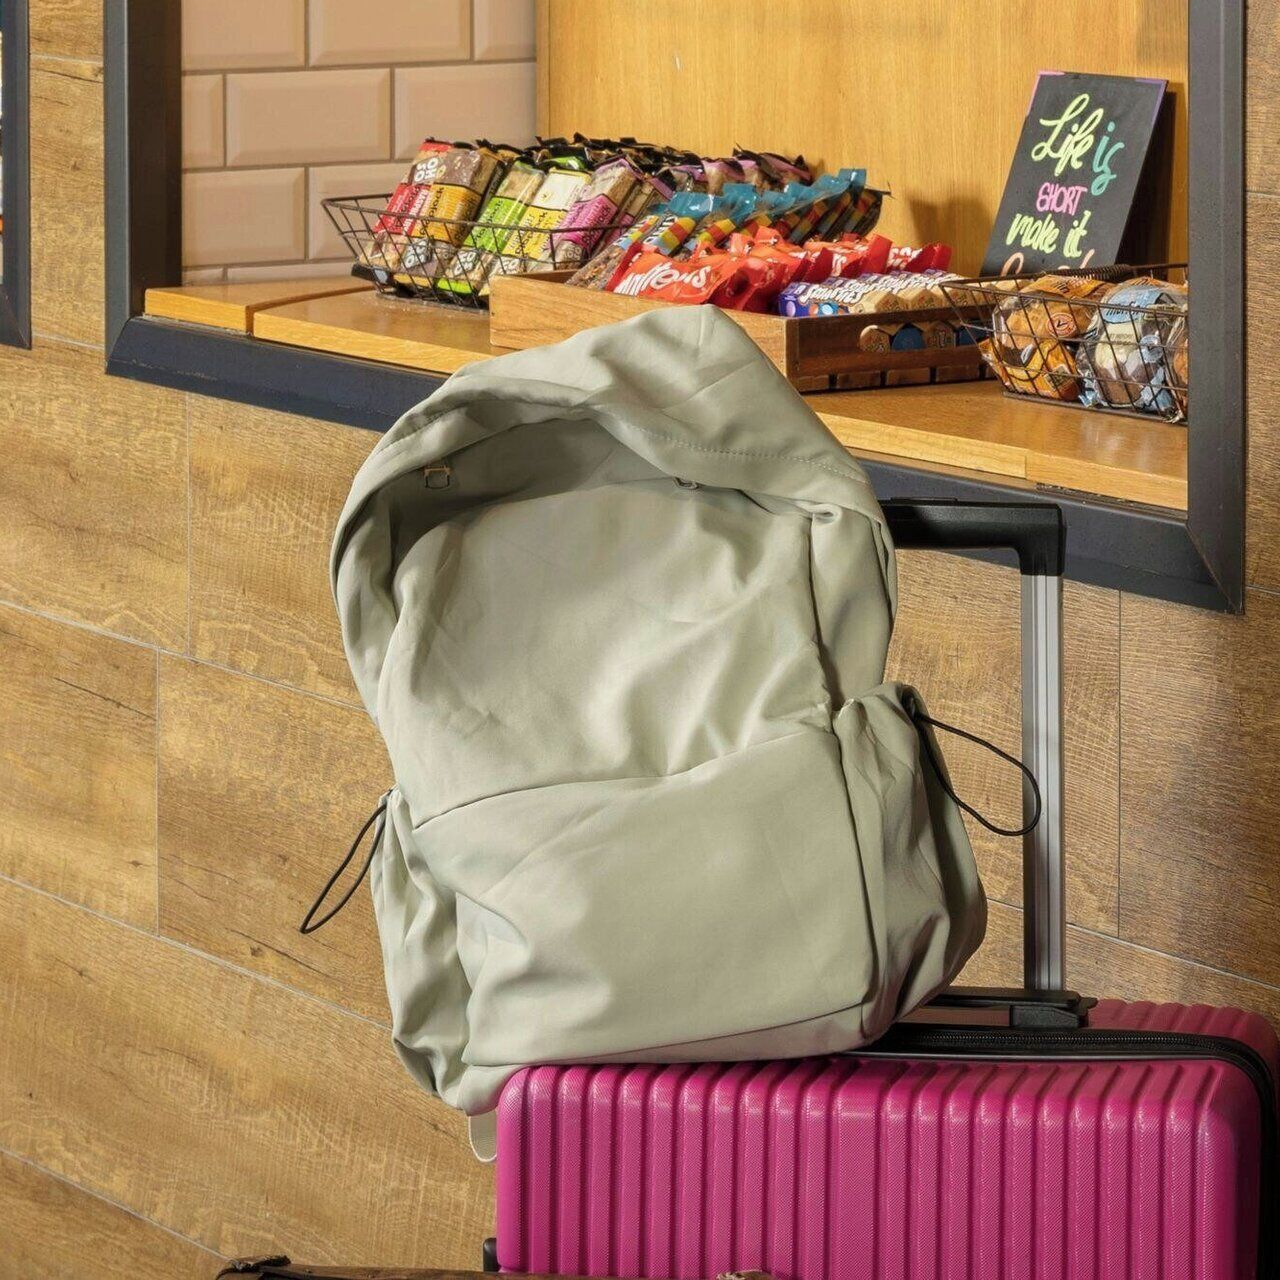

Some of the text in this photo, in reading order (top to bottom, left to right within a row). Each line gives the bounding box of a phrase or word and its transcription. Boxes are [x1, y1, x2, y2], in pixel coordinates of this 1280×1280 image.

[1031, 93, 1126, 197] Life is
[1005, 209, 1093, 259] make it
